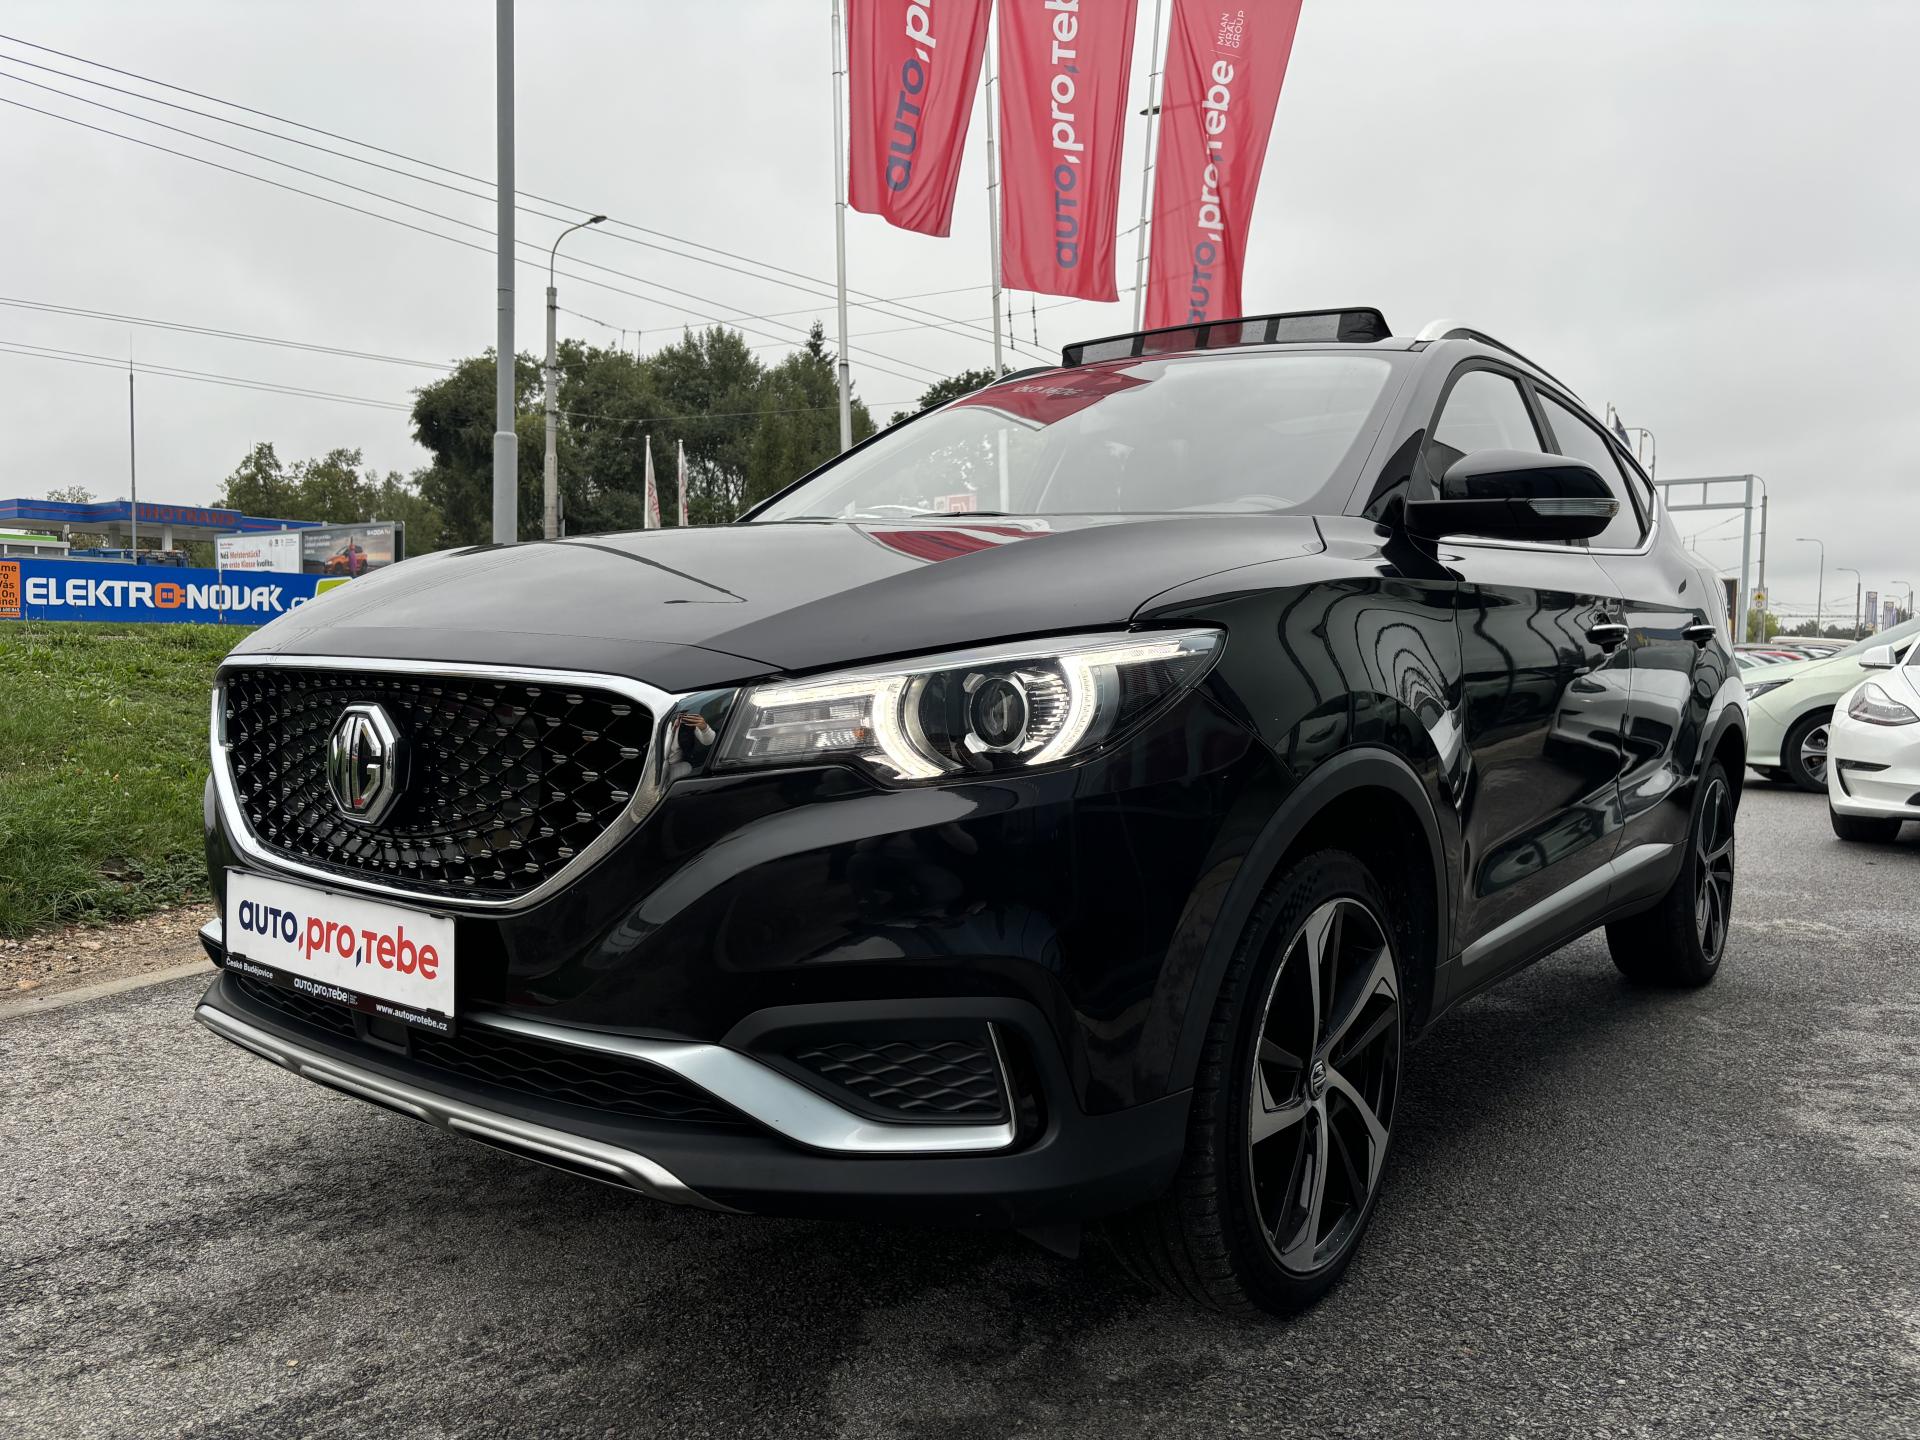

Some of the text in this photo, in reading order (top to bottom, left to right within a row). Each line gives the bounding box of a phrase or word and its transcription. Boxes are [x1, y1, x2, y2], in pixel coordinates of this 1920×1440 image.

[1216, 12, 1230, 46] MILAN
[1231, 10, 1244, 49] GROUP
[226, 956, 274, 979] České Budějovice
[375, 1003, 448, 1031] www.autoprotebe.cz
